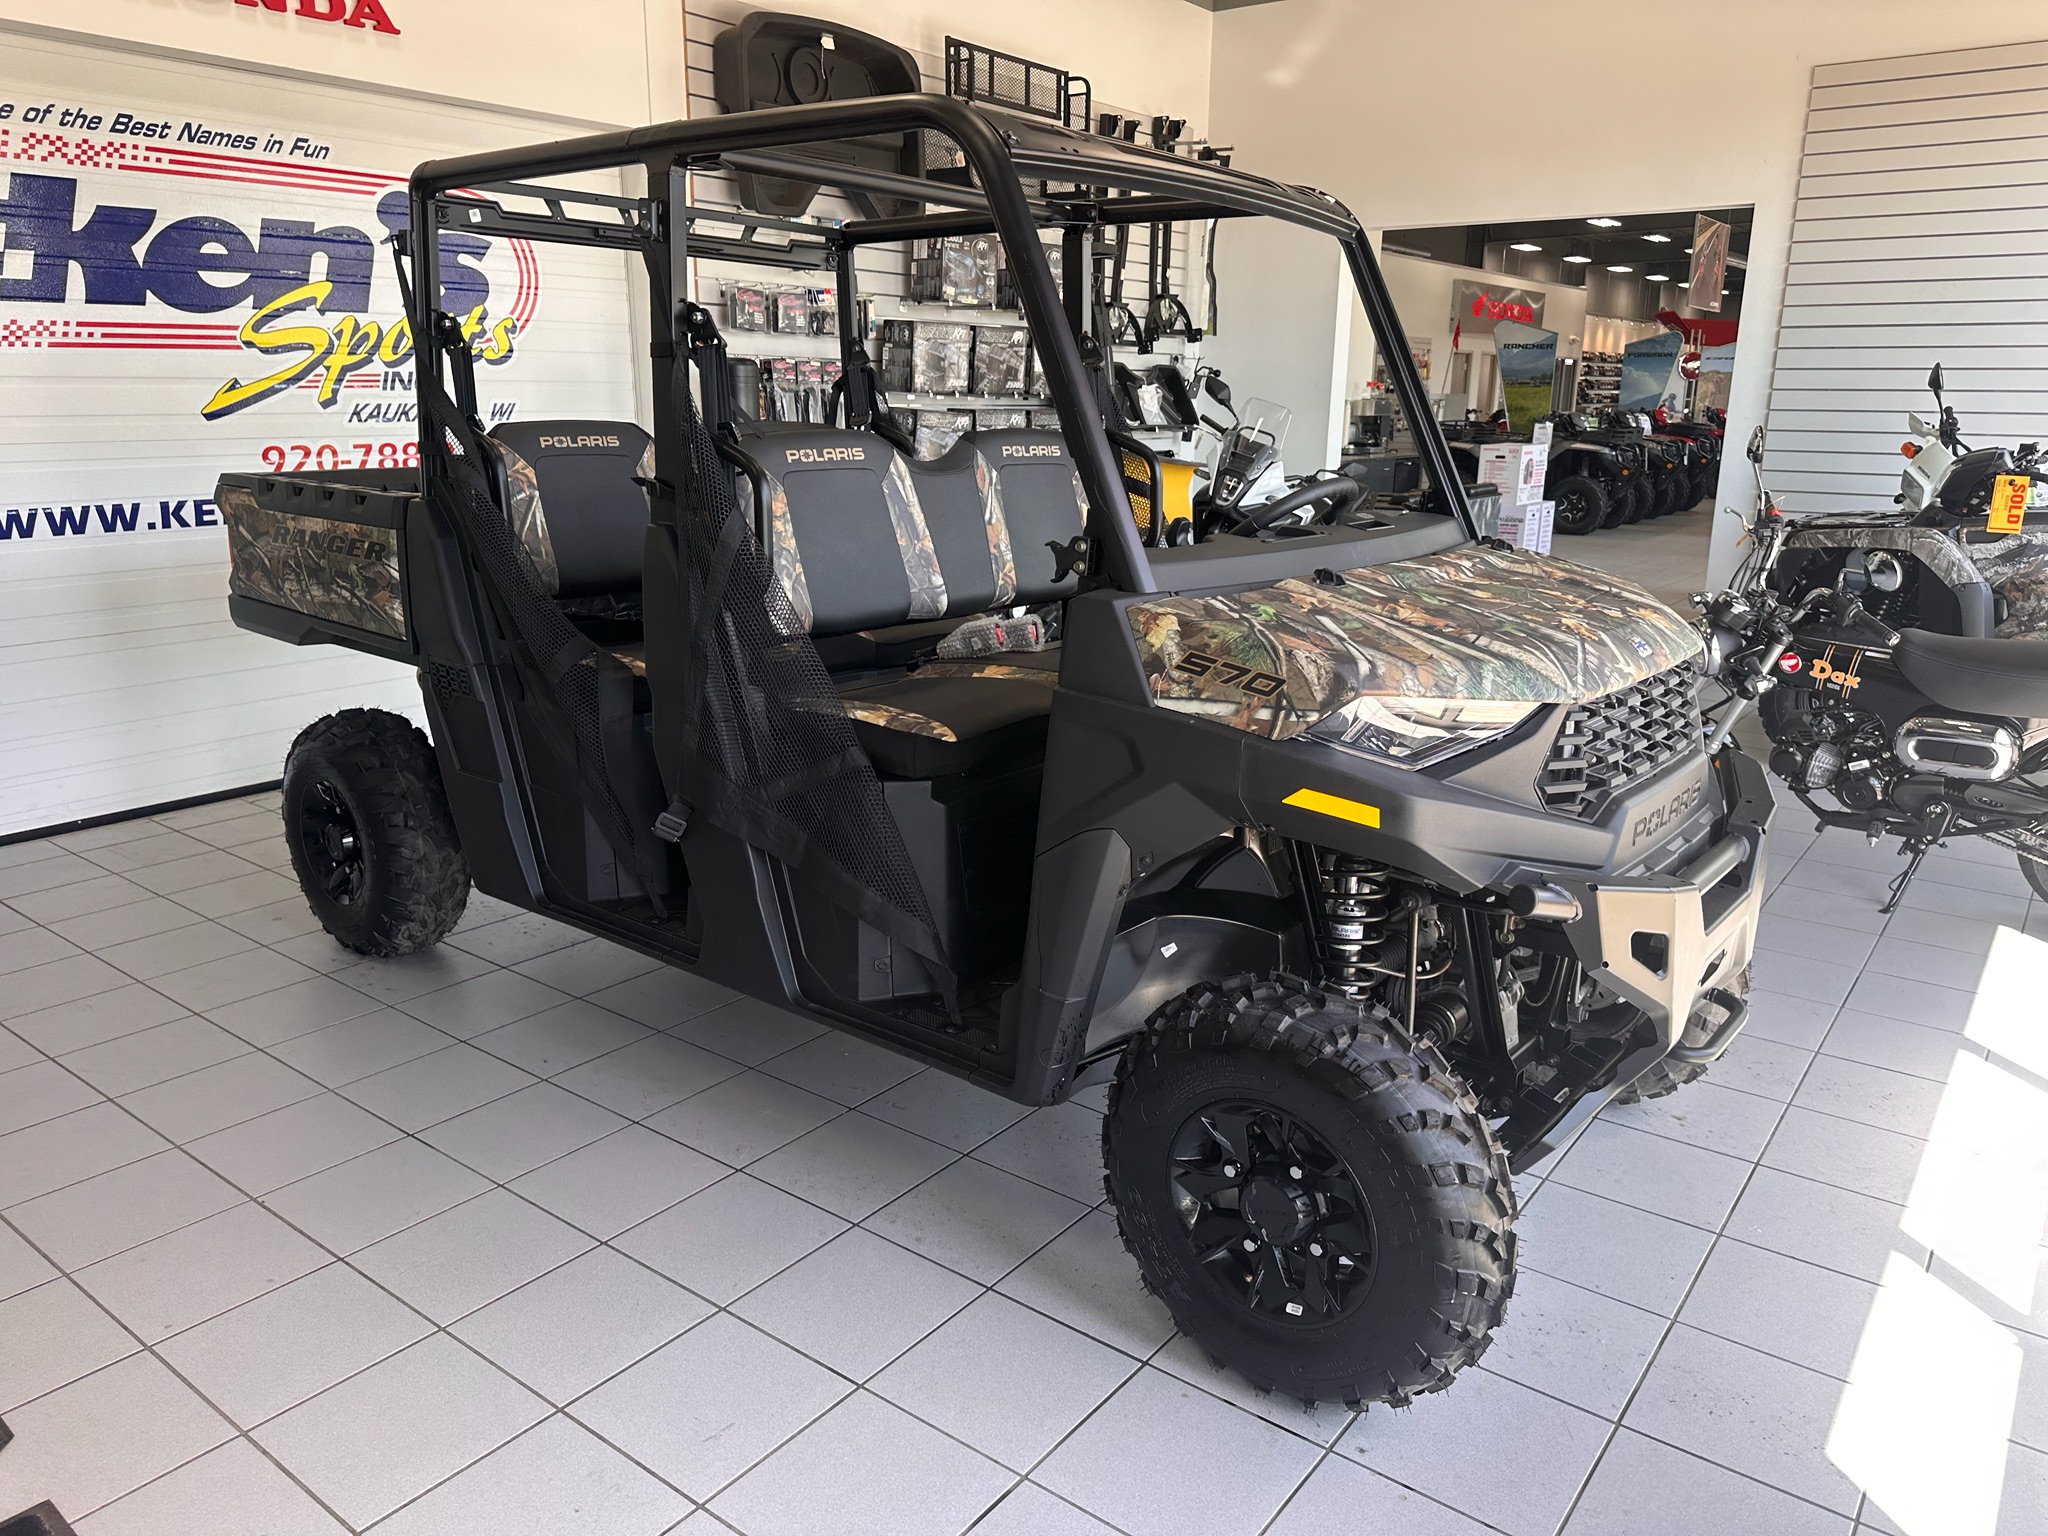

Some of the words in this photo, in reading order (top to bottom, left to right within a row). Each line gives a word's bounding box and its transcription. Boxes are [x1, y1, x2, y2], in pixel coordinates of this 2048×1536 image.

[22, 103, 55, 125] of
[59, 107, 102, 131] the
[109, 113, 172, 140] Best
[177, 121, 258, 151] Names
[262, 133, 284, 153] in
[289, 137, 331, 160] Fun
[1487, 301, 1533, 323] HONDA
[200, 281, 518, 421] Spots
[382, 371, 418, 391] IN
[348, 402, 418, 423] KAUK
[490, 403, 516, 421] WI
[539, 434, 620, 449] POLARIS
[785, 446, 866, 464] POLARIS
[1001, 445, 1061, 458] POLARIS
[0, 499, 228, 541] WWW.KE
[2006, 483, 2026, 525] SOLD
[271, 524, 387, 563] RANGER
[1172, 649, 1287, 698] 570
[1808, 658, 1861, 689] Dax
[1632, 778, 1702, 847] POLARIS
